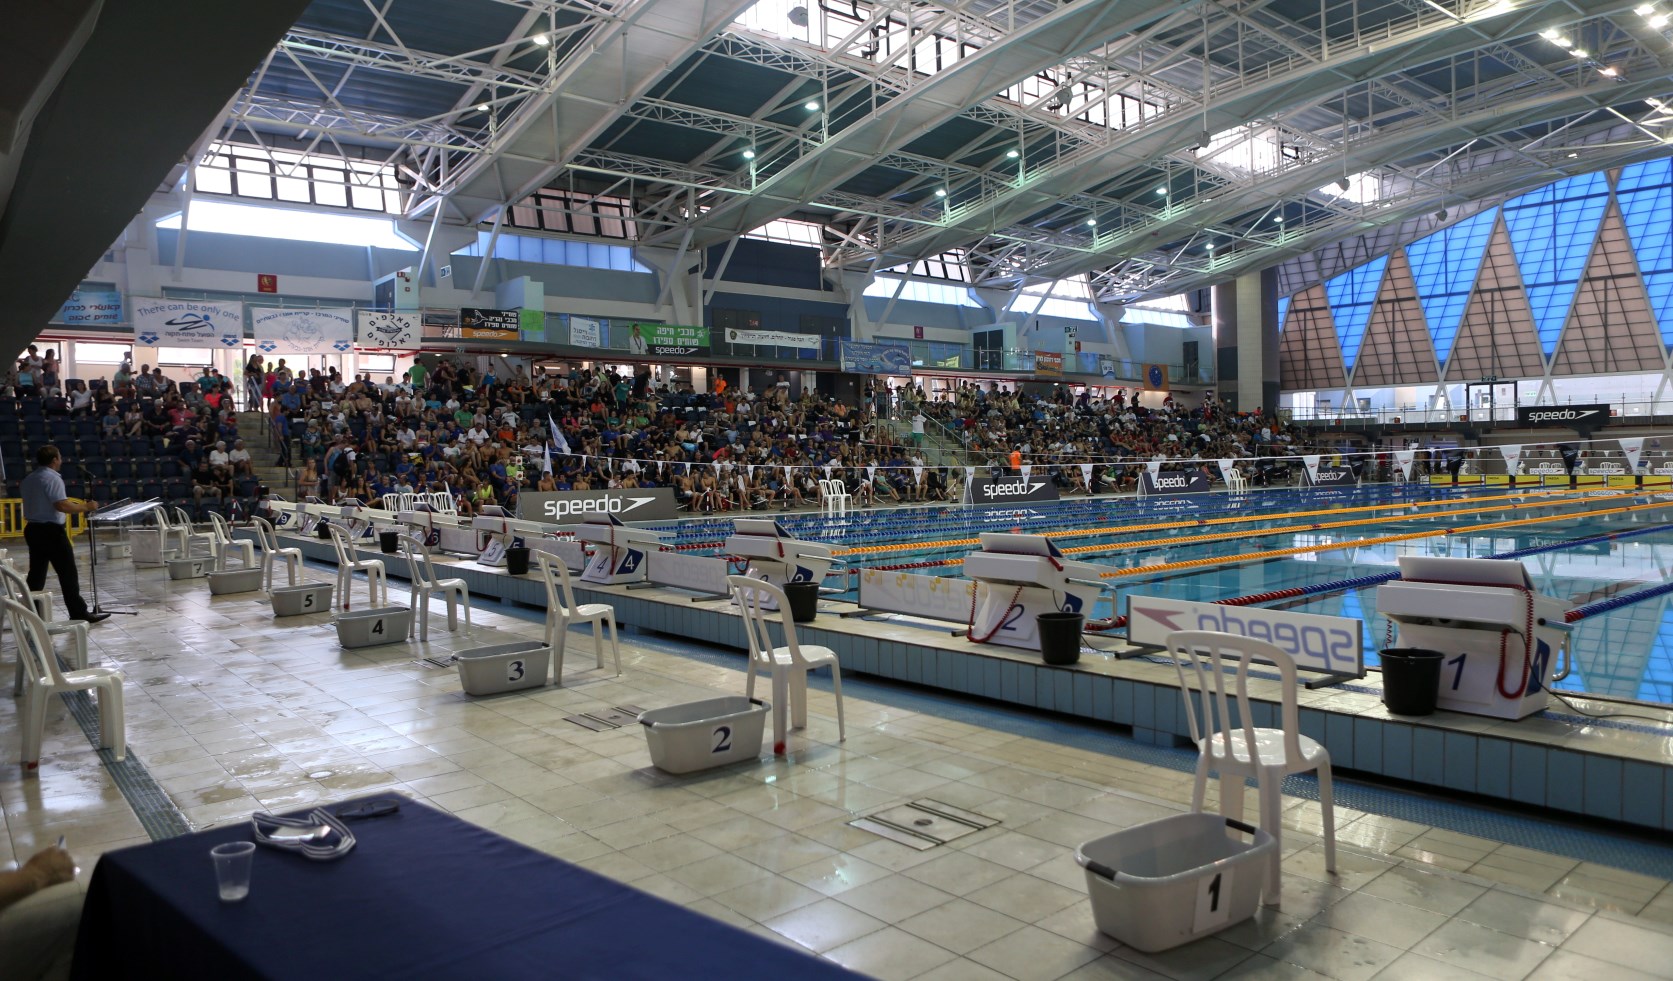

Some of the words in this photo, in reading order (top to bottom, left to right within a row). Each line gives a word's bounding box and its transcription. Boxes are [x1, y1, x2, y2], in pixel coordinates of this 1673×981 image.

[137, 304, 165, 317] There
[187, 303, 198, 311] be
[201, 305, 220, 316] only
[222, 310, 240, 321] one
[657, 327, 674, 335] חיפה
[655, 346, 685, 355] speedo
[1528, 408, 1576, 423] speedo
[983, 480, 1027, 499] speedo
[544, 494, 621, 520] speedo
[281, 515, 287, 524] 9
[488, 543, 499, 556] 5
[597, 556, 609, 573] 4
[625, 554, 635, 570] 4
[304, 594, 313, 608] 5
[1002, 603, 1025, 631] 2
[372, 619, 384, 635] 4
[508, 660, 525, 681] 3
[1448, 653, 1467, 690] 1
[1536, 653, 1543, 684] 1
[711, 726, 732, 753] 2
[1208, 873, 1222, 912] 1
